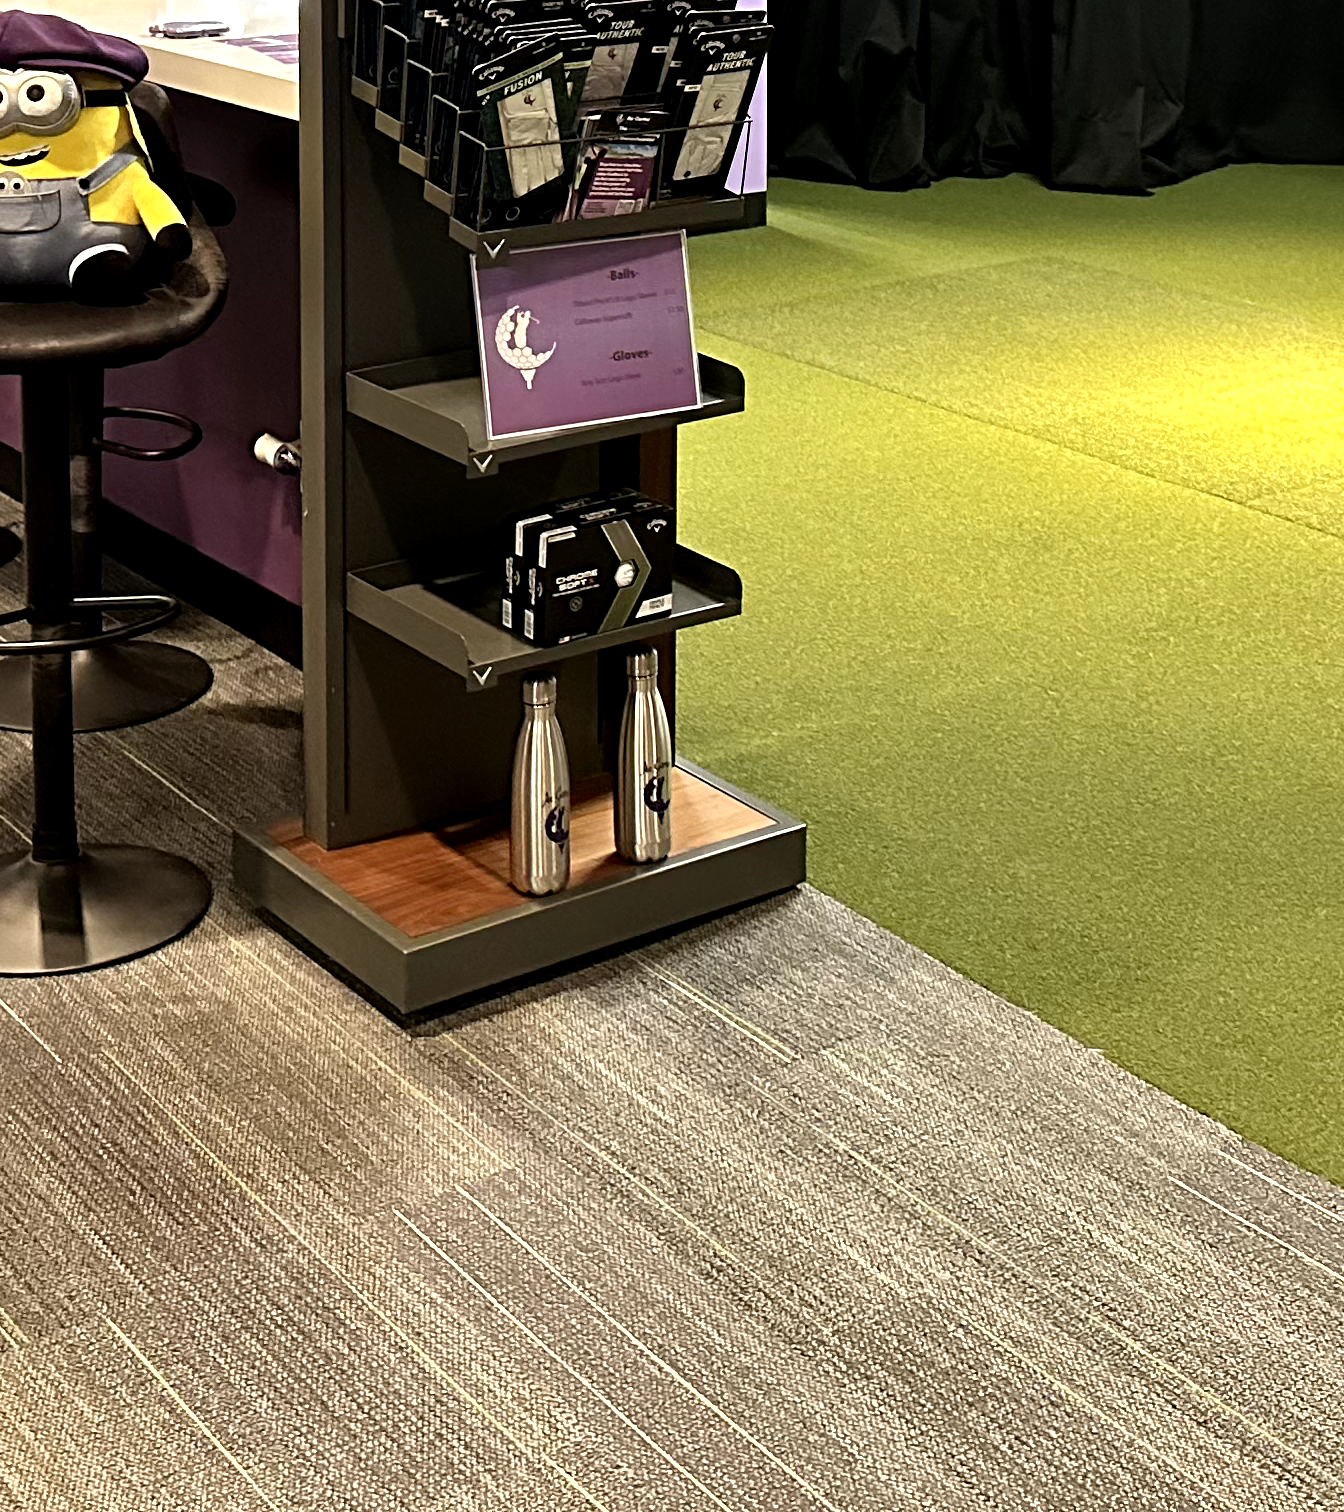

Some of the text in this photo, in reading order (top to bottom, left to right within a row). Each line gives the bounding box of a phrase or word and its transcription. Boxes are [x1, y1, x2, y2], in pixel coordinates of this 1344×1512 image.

[610, 19, 636, 30] TOUR
[596, 26, 645, 40] AUTHENTIC
[721, 50, 747, 61] TOUR
[706, 57, 756, 72] AUTHENTIC
[504, 70, 543, 96] FUSION
[556, 568, 598, 585] CHROME
[558, 578, 588, 592] SOFT
